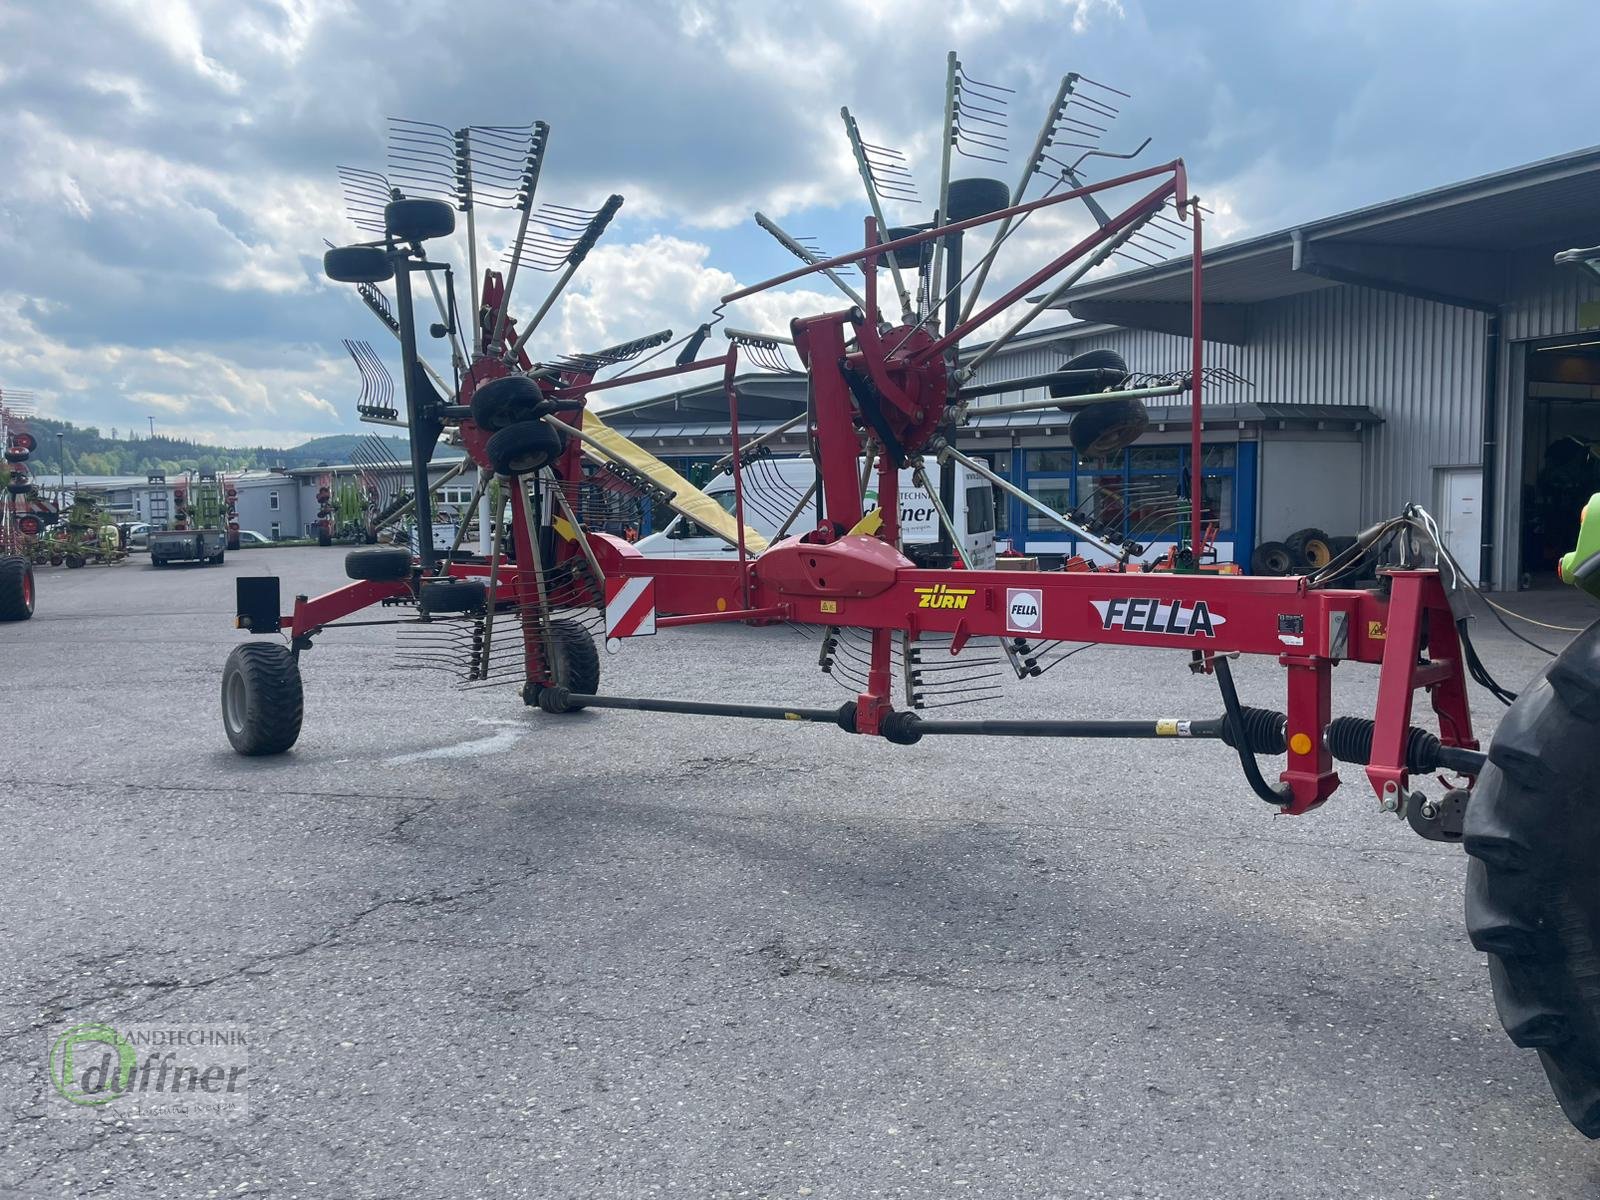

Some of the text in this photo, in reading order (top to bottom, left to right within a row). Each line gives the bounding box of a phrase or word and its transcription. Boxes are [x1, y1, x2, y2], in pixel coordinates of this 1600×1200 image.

[914, 584, 976, 610] ZÜRN
[1011, 604, 1038, 616] FELLA
[1102, 597, 1216, 638] FELLA
